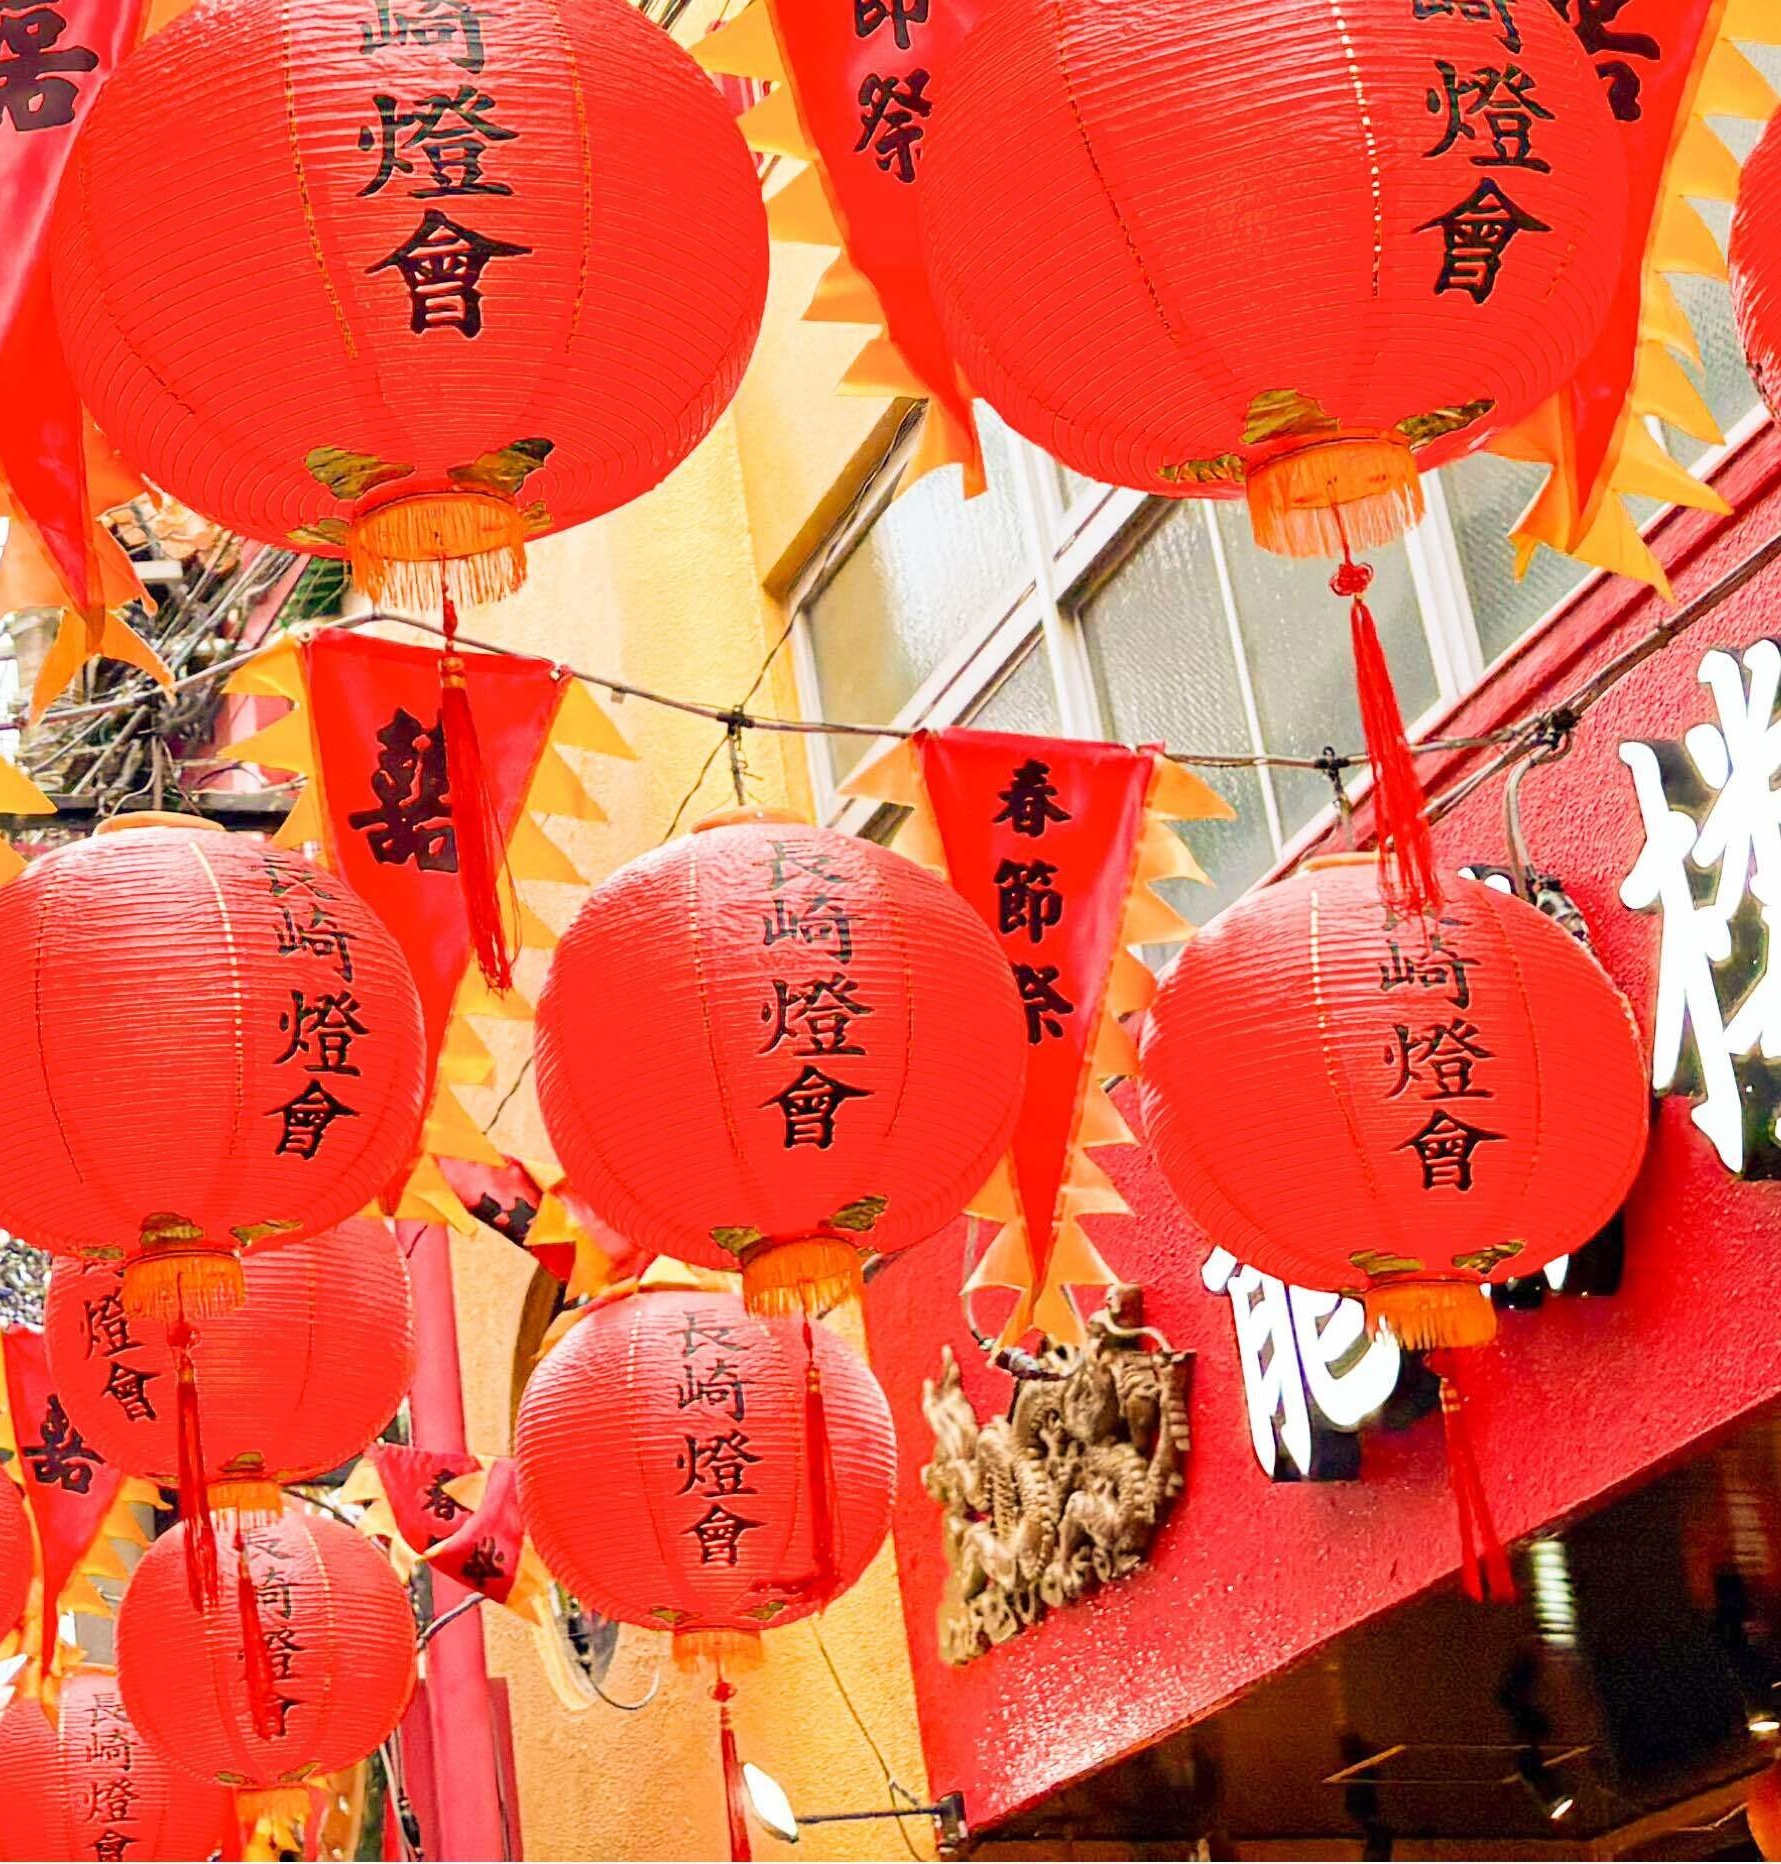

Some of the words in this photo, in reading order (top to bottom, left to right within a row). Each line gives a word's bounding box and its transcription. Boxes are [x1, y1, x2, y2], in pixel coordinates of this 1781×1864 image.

[262, 850, 371, 1161] 長崎燈會
[752, 838, 876, 1151] 長崎燈會
[991, 758, 1075, 1046] 春節祭
[78, 1262, 163, 1423] 燈會
[668, 1310, 770, 1567] 長崎燈會
